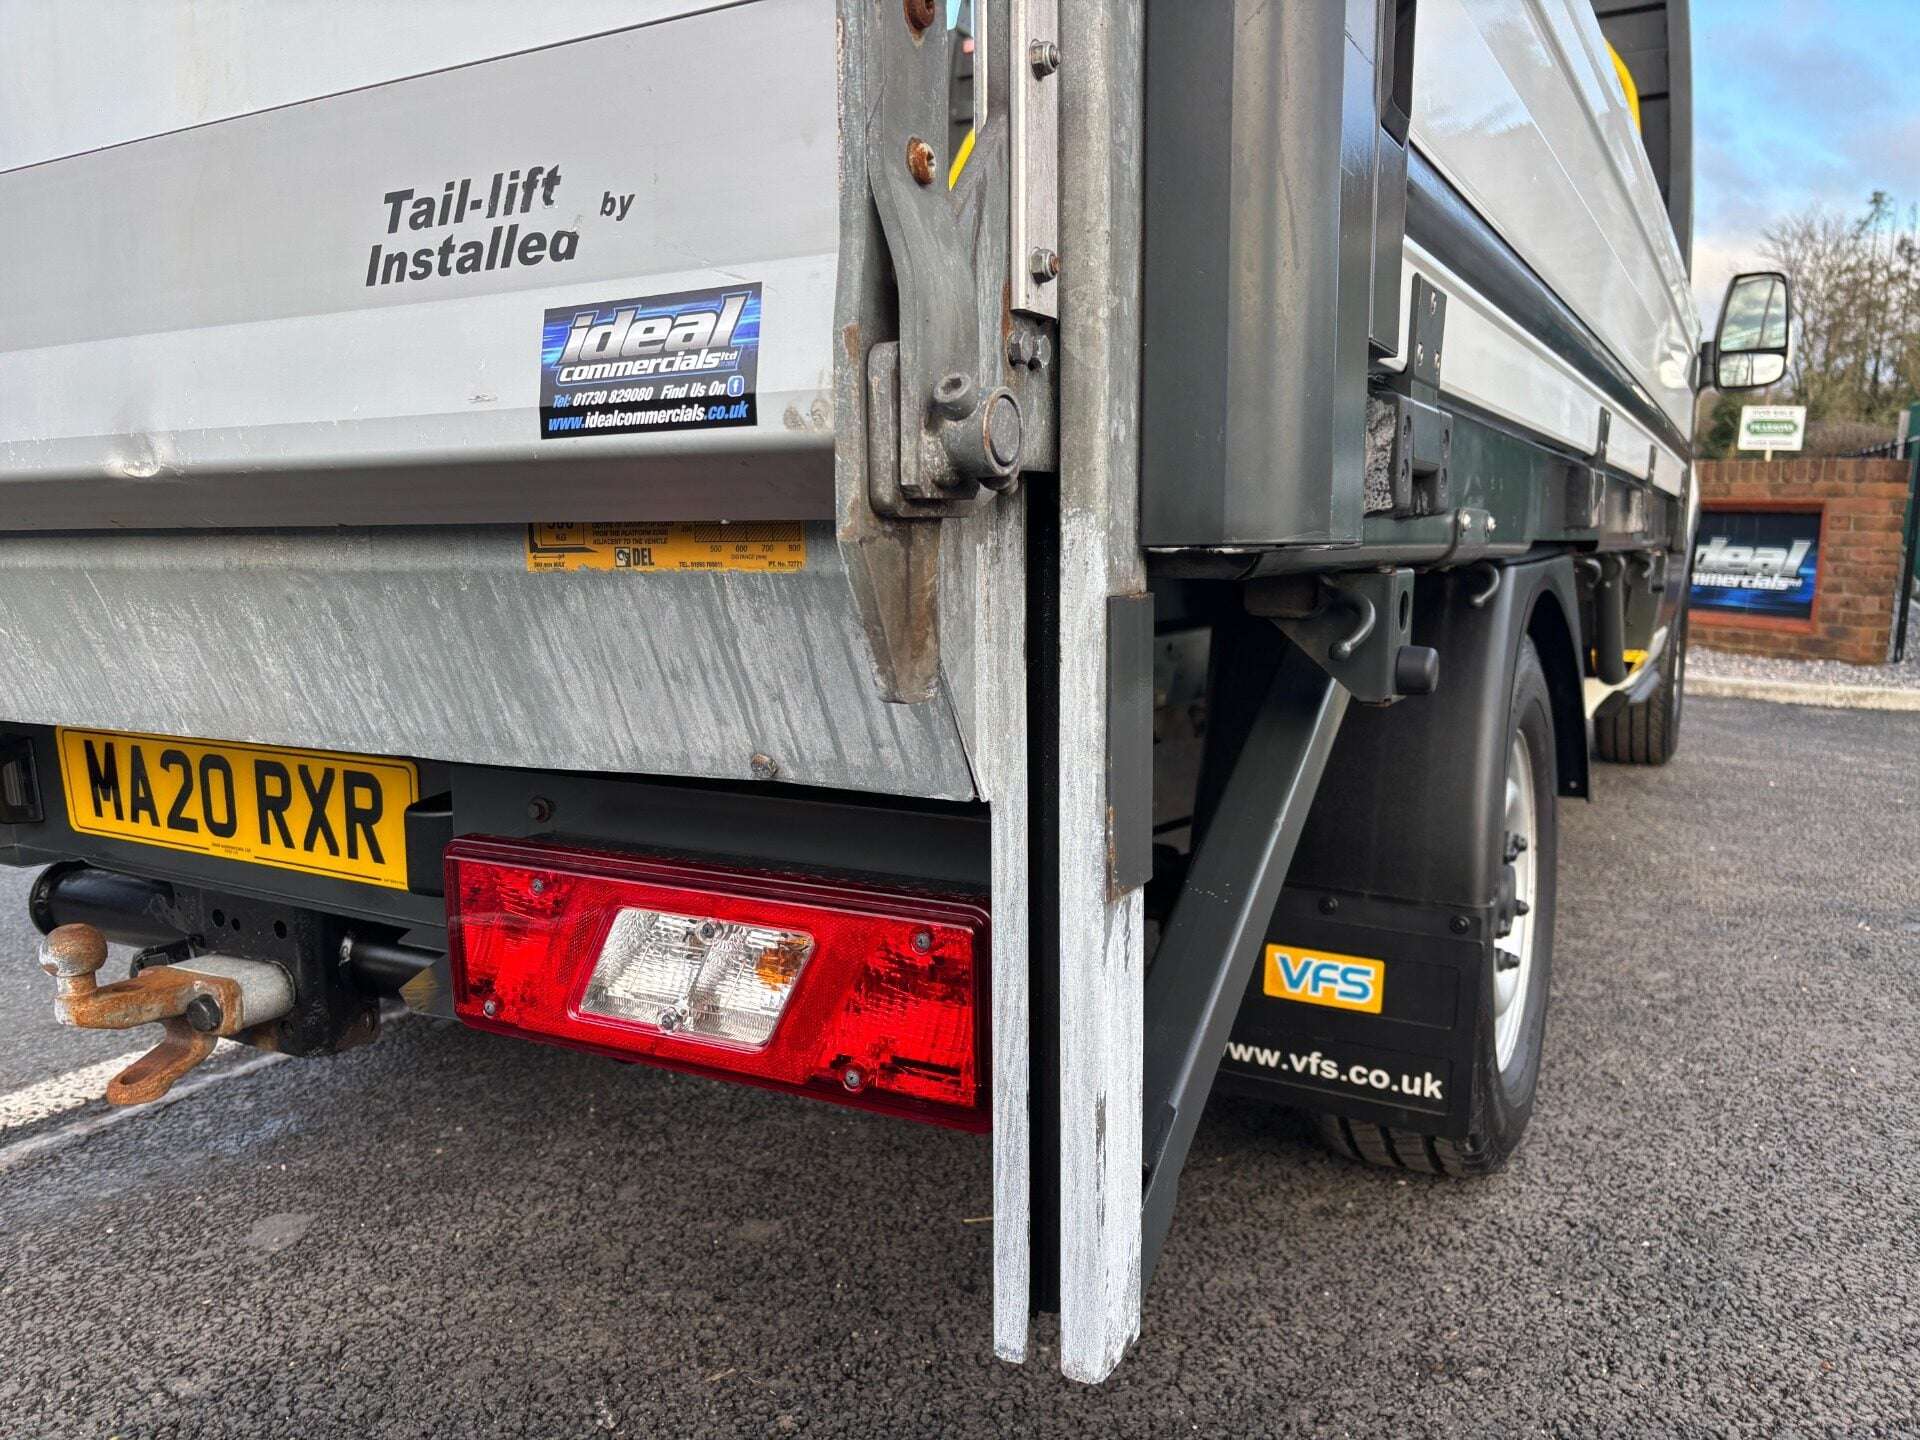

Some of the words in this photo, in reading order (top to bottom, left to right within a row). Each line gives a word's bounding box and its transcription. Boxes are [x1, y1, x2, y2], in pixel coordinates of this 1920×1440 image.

[384, 164, 562, 234] Tail-lift
[600, 191, 635, 222] by
[559, 294, 750, 362] ideal
[559, 348, 721, 383] commercials
[548, 400, 750, 432] www.idealcommercials.co.uk
[553, 394, 570, 408] Tel:
[572, 391, 607, 407] 01730
[608, 386, 654, 403] 829080
[660, 384, 687, 400] Find
[689, 382, 707, 398] Us
[708, 380, 727, 396] On
[632, 548, 655, 566] DEL
[1694, 537, 1811, 576] deal
[83, 740, 238, 838] MA20
[255, 759, 386, 865] RXR
[1275, 953, 1374, 1002] VFS
[1223, 1041, 1443, 1100] ww.vfs.co.uk
